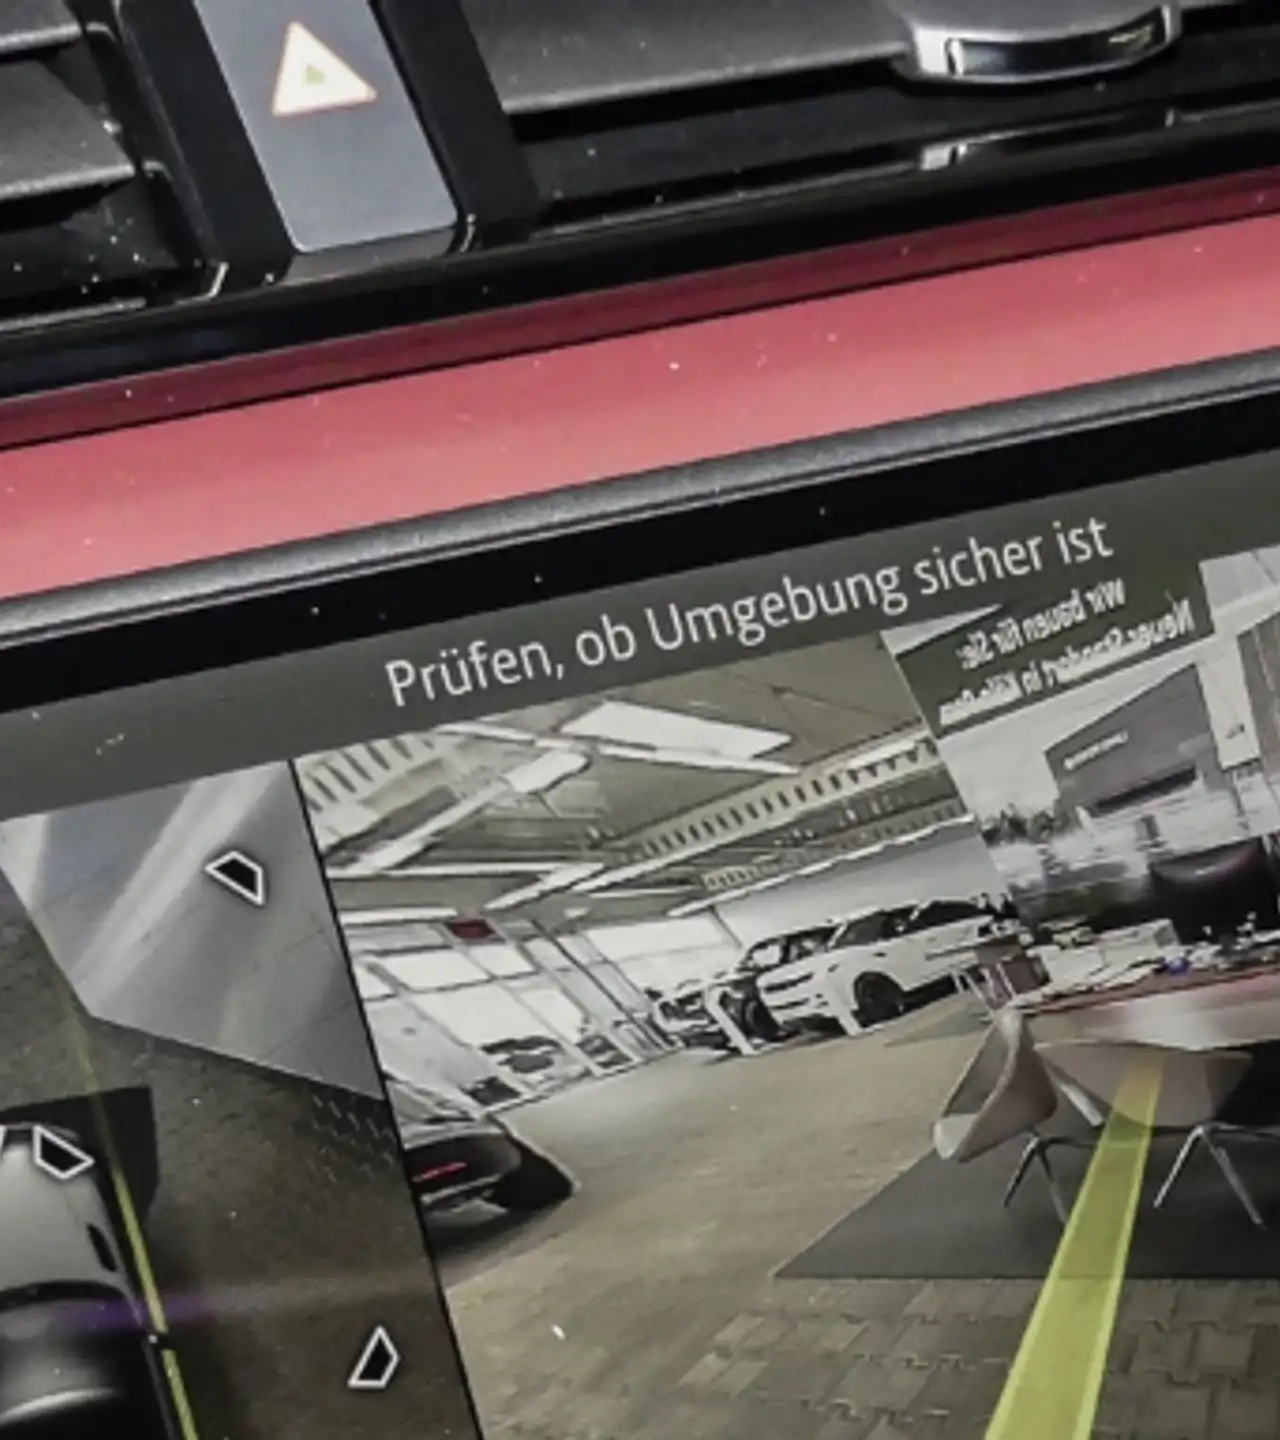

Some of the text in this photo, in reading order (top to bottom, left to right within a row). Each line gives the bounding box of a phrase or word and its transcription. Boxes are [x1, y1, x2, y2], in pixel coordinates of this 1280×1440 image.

[384, 516, 1115, 707] Prüfen, ob Umgebung sicher ist
